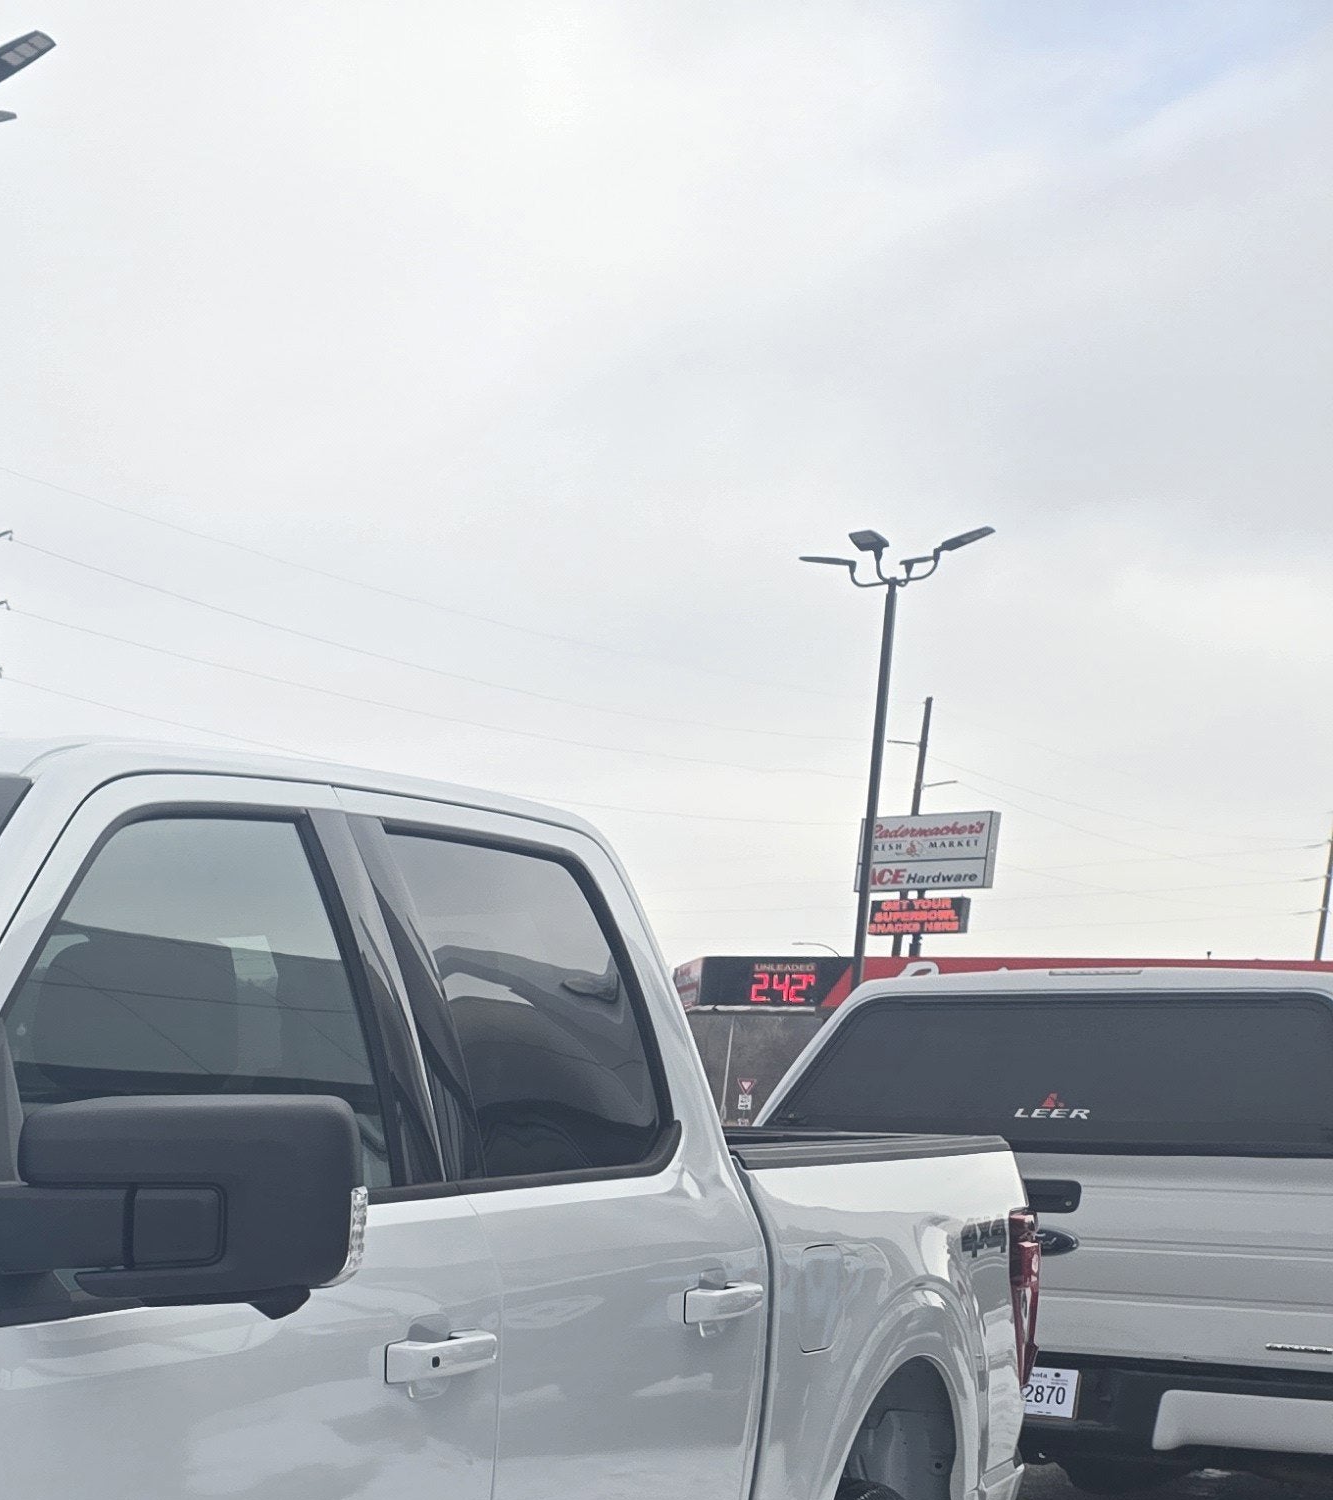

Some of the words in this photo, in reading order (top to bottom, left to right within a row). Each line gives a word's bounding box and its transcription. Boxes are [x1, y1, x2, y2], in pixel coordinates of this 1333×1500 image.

[873, 842, 902, 852] RESH
[928, 838, 979, 849] MARKET
[906, 871, 978, 884] Hardware
[881, 899, 910, 911] GET
[913, 897, 952, 910] YOUR
[754, 963, 815, 971] UNLEADED
[1014, 1108, 1090, 1120] LEER
